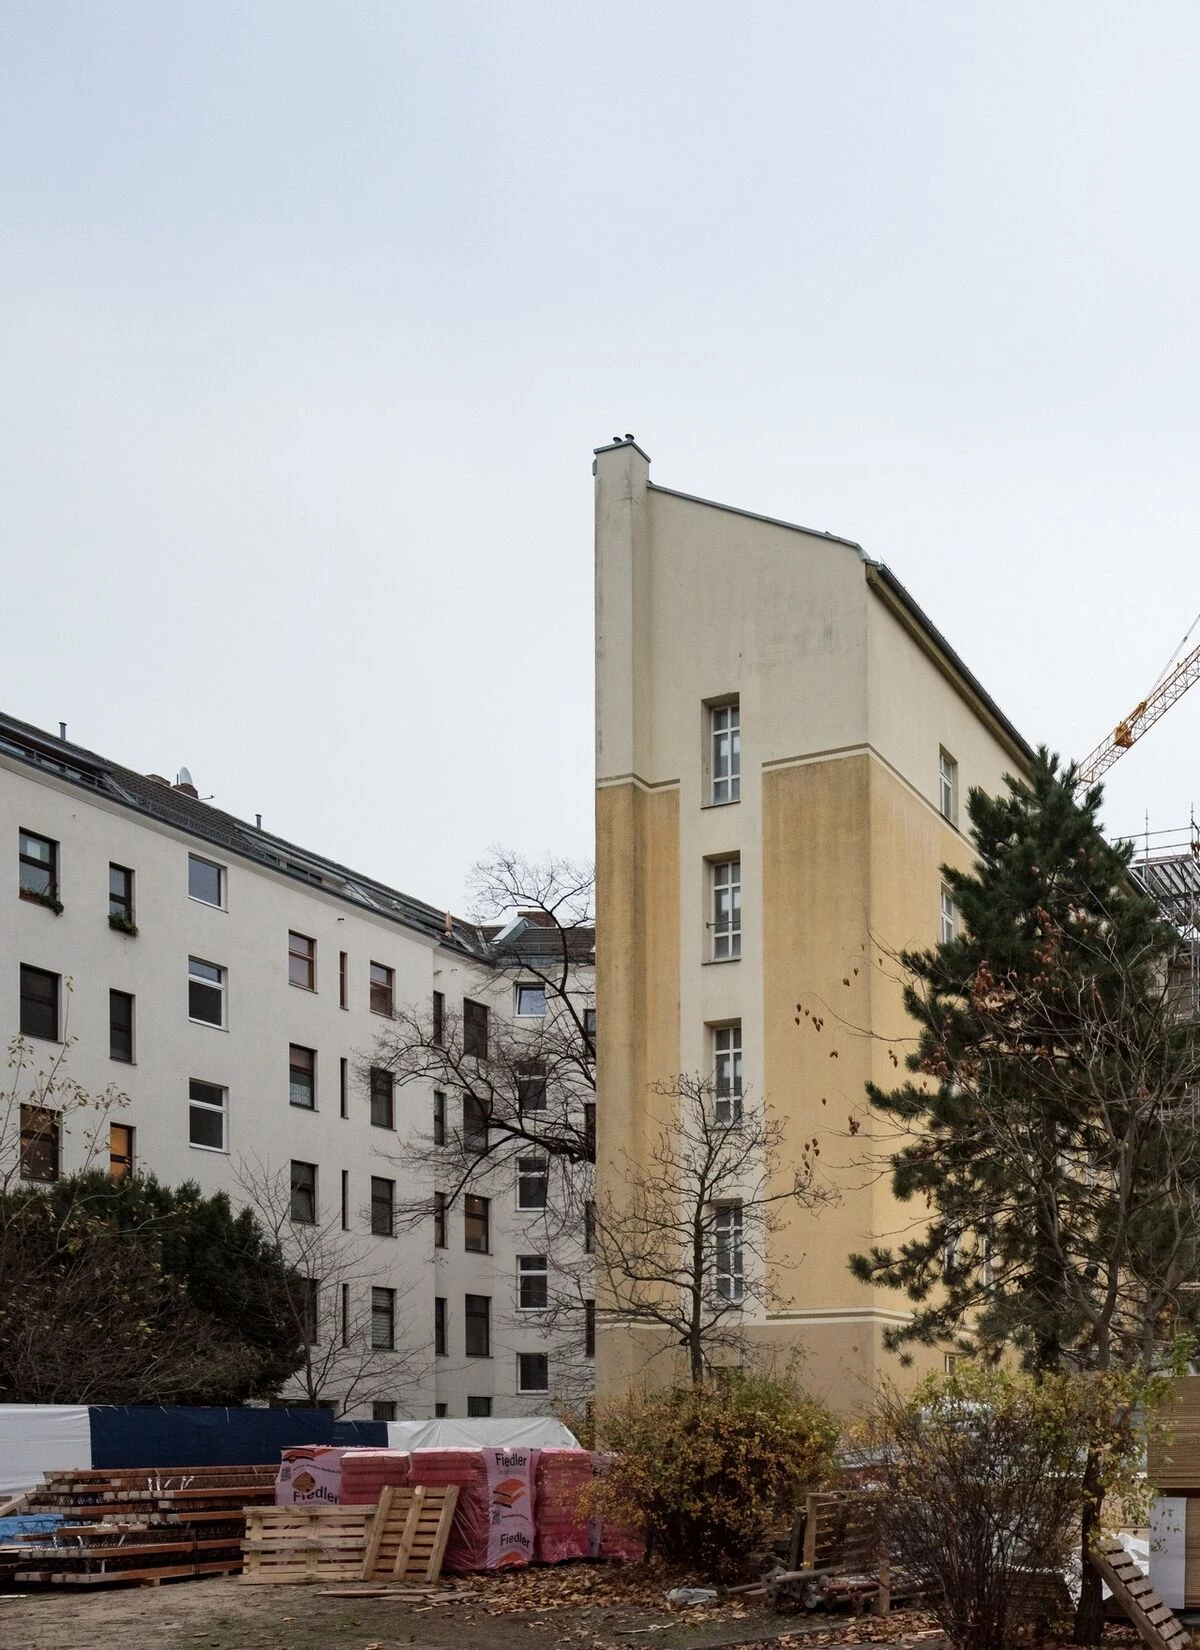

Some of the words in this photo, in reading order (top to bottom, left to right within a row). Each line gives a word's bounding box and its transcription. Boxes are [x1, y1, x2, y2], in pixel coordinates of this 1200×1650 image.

[495, 1452, 527, 1467] Fiedler
[293, 1485, 341, 1504] Fiedler
[500, 1532, 530, 1549] Fiedler
